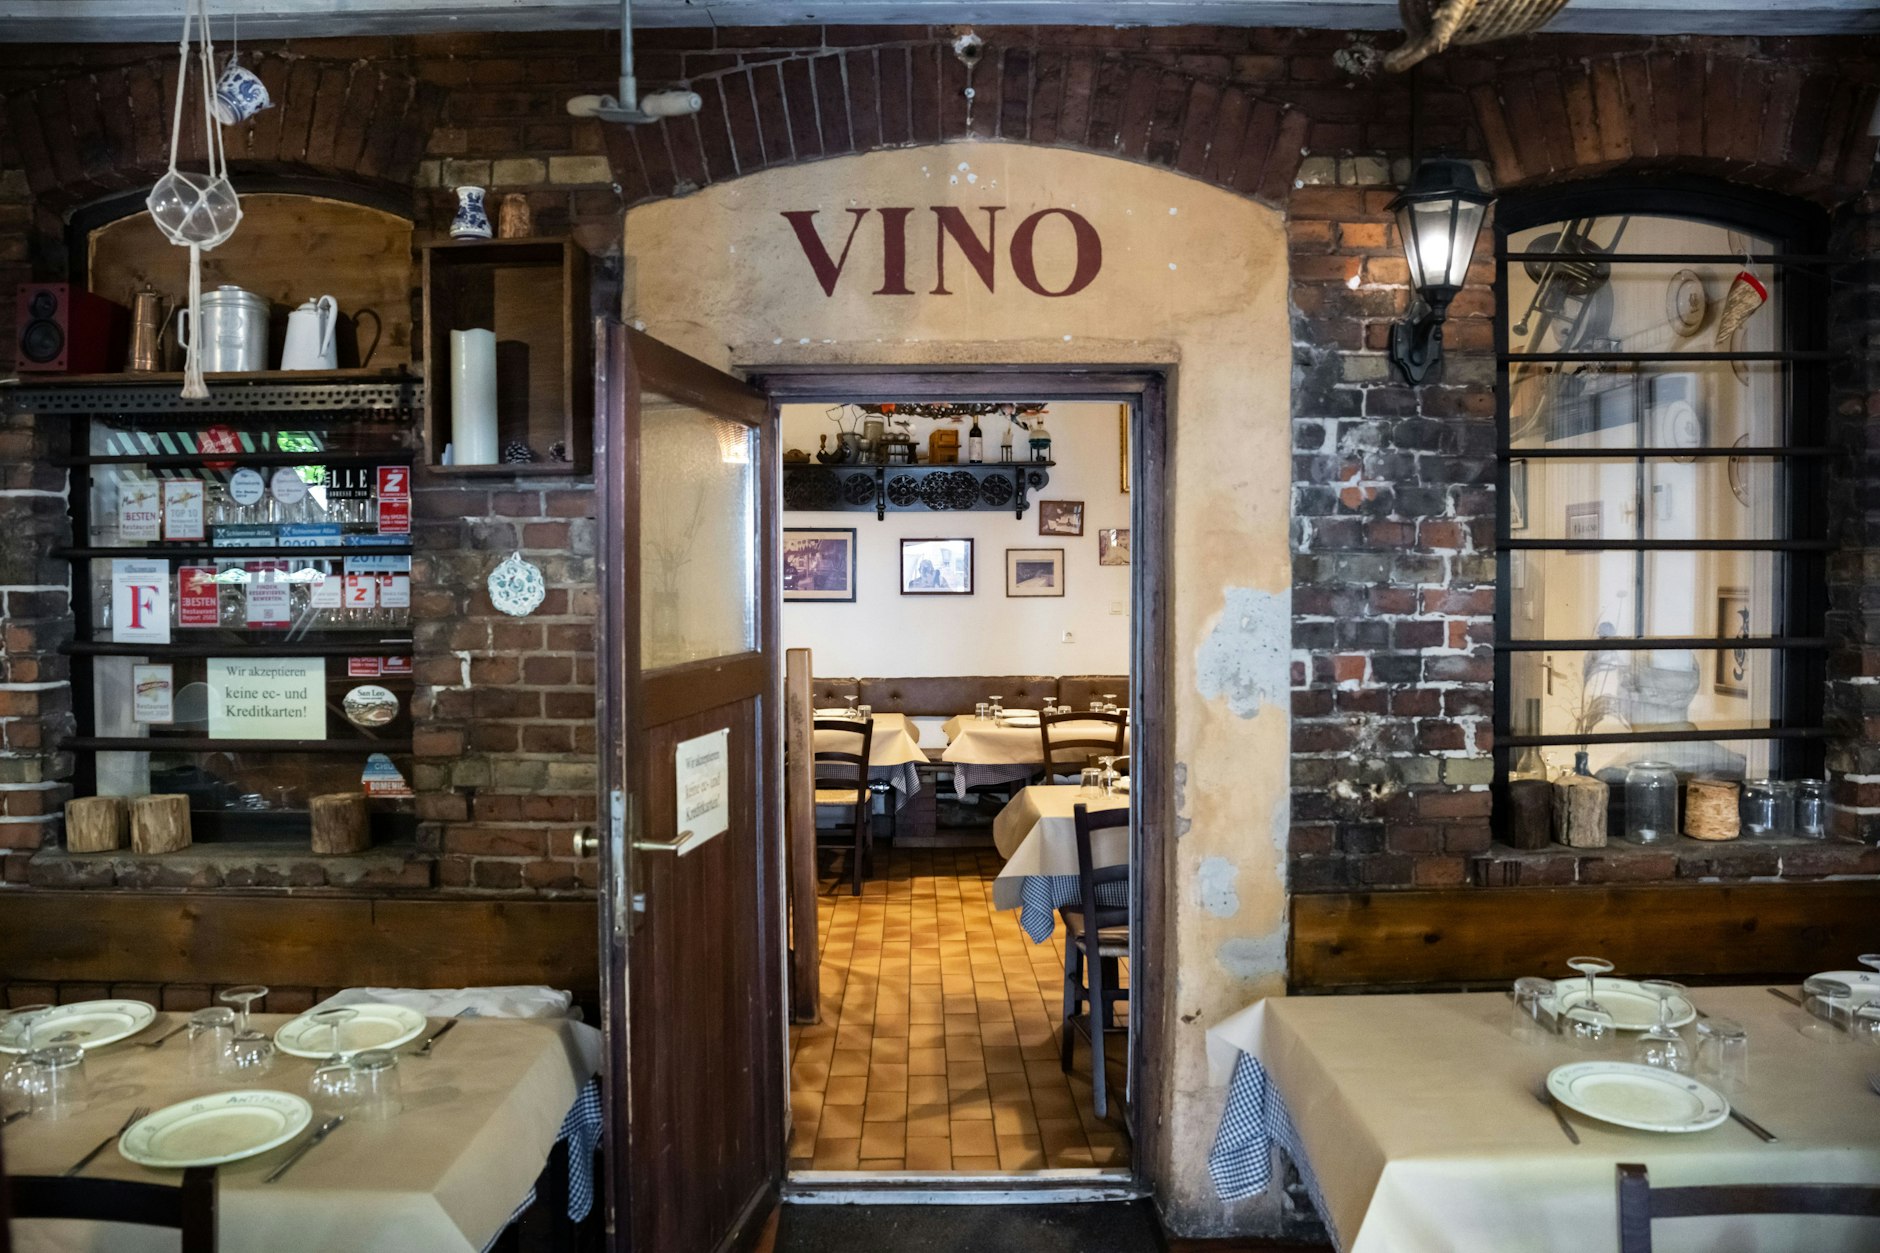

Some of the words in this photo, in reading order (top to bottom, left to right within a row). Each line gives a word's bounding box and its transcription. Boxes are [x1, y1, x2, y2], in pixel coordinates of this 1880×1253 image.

[780, 205, 1102, 298] VINO
[383, 473, 404, 493] Z
[126, 511, 156, 521] BESTEN
[170, 509, 186, 518] TOP
[188, 509, 198, 518] 10
[353, 587, 368, 602] Z
[126, 585, 160, 630] F
[185, 597, 217, 607] BESTEN
[226, 666, 247, 677] Wir
[248, 666, 307, 679] akzeptieren
[225, 686, 259, 699] keine
[261, 689, 281, 699] ec-
[284, 687, 308, 700] und
[357, 689, 371, 697] San
[371, 689, 386, 697] Leo
[225, 705, 307, 718] Kreditkarten!
